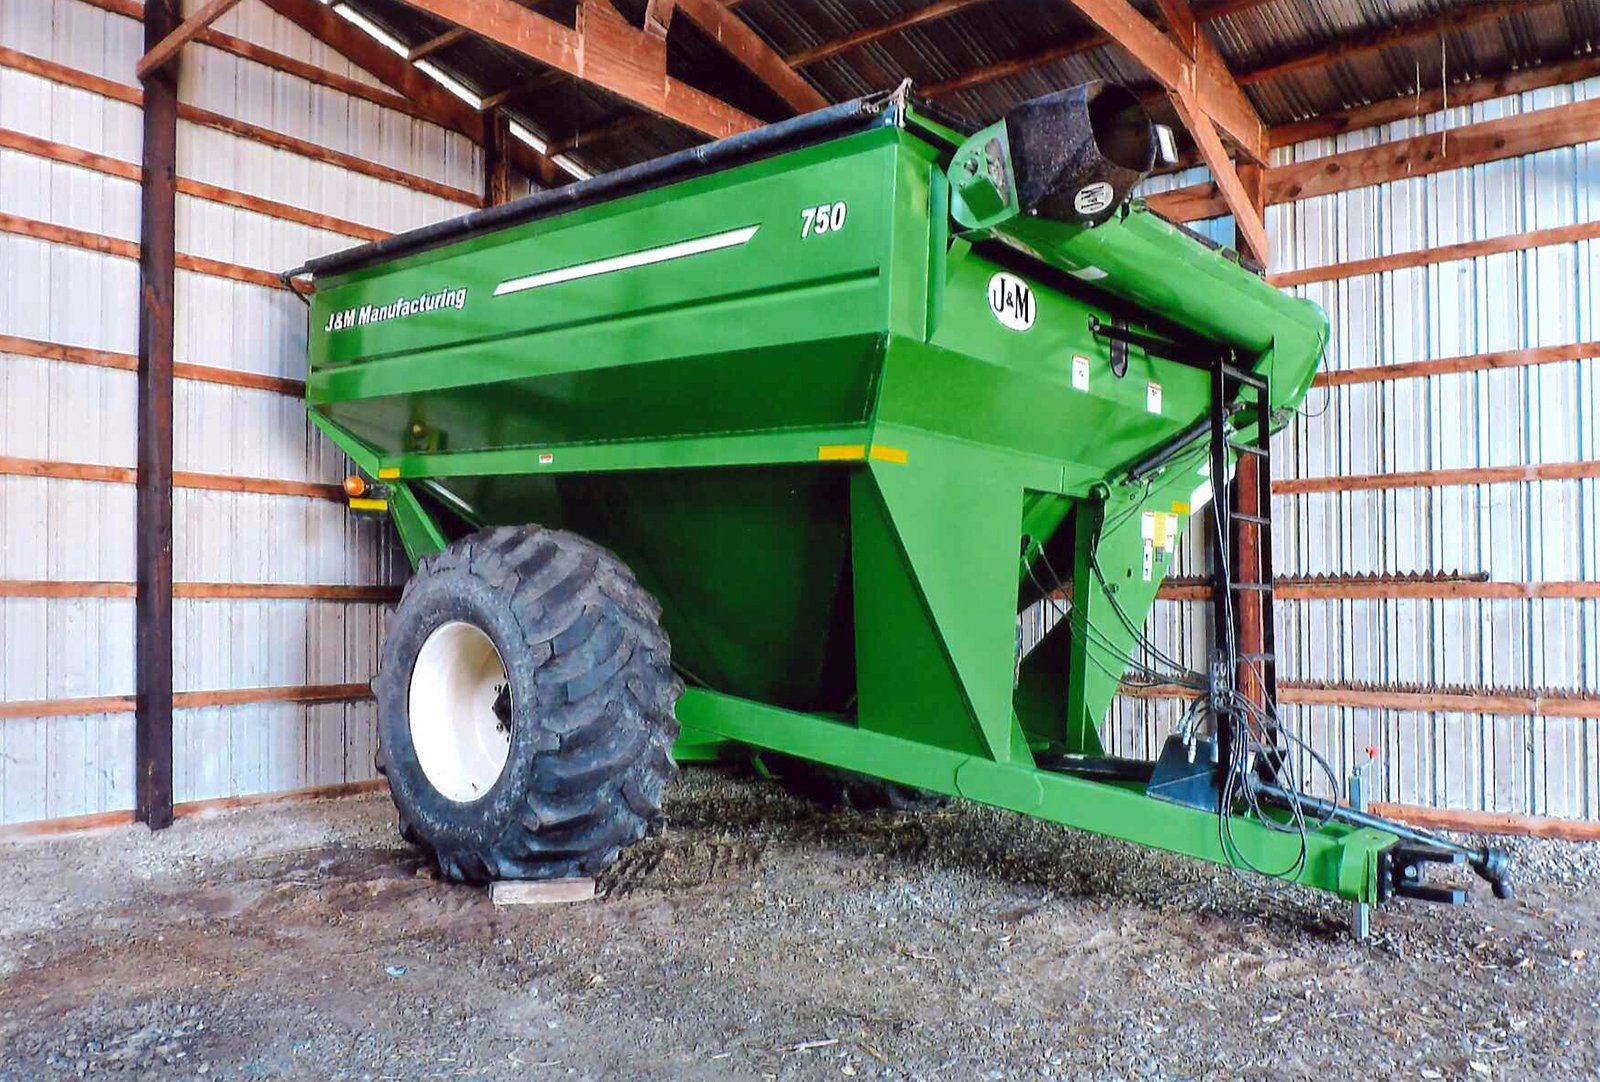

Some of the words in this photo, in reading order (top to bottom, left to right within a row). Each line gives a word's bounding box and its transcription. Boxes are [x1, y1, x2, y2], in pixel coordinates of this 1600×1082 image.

[801, 200, 847, 238] 750
[324, 308, 356, 332] J&M
[358, 286, 467, 325] Manufacturing
[993, 277, 1029, 324] J&M
